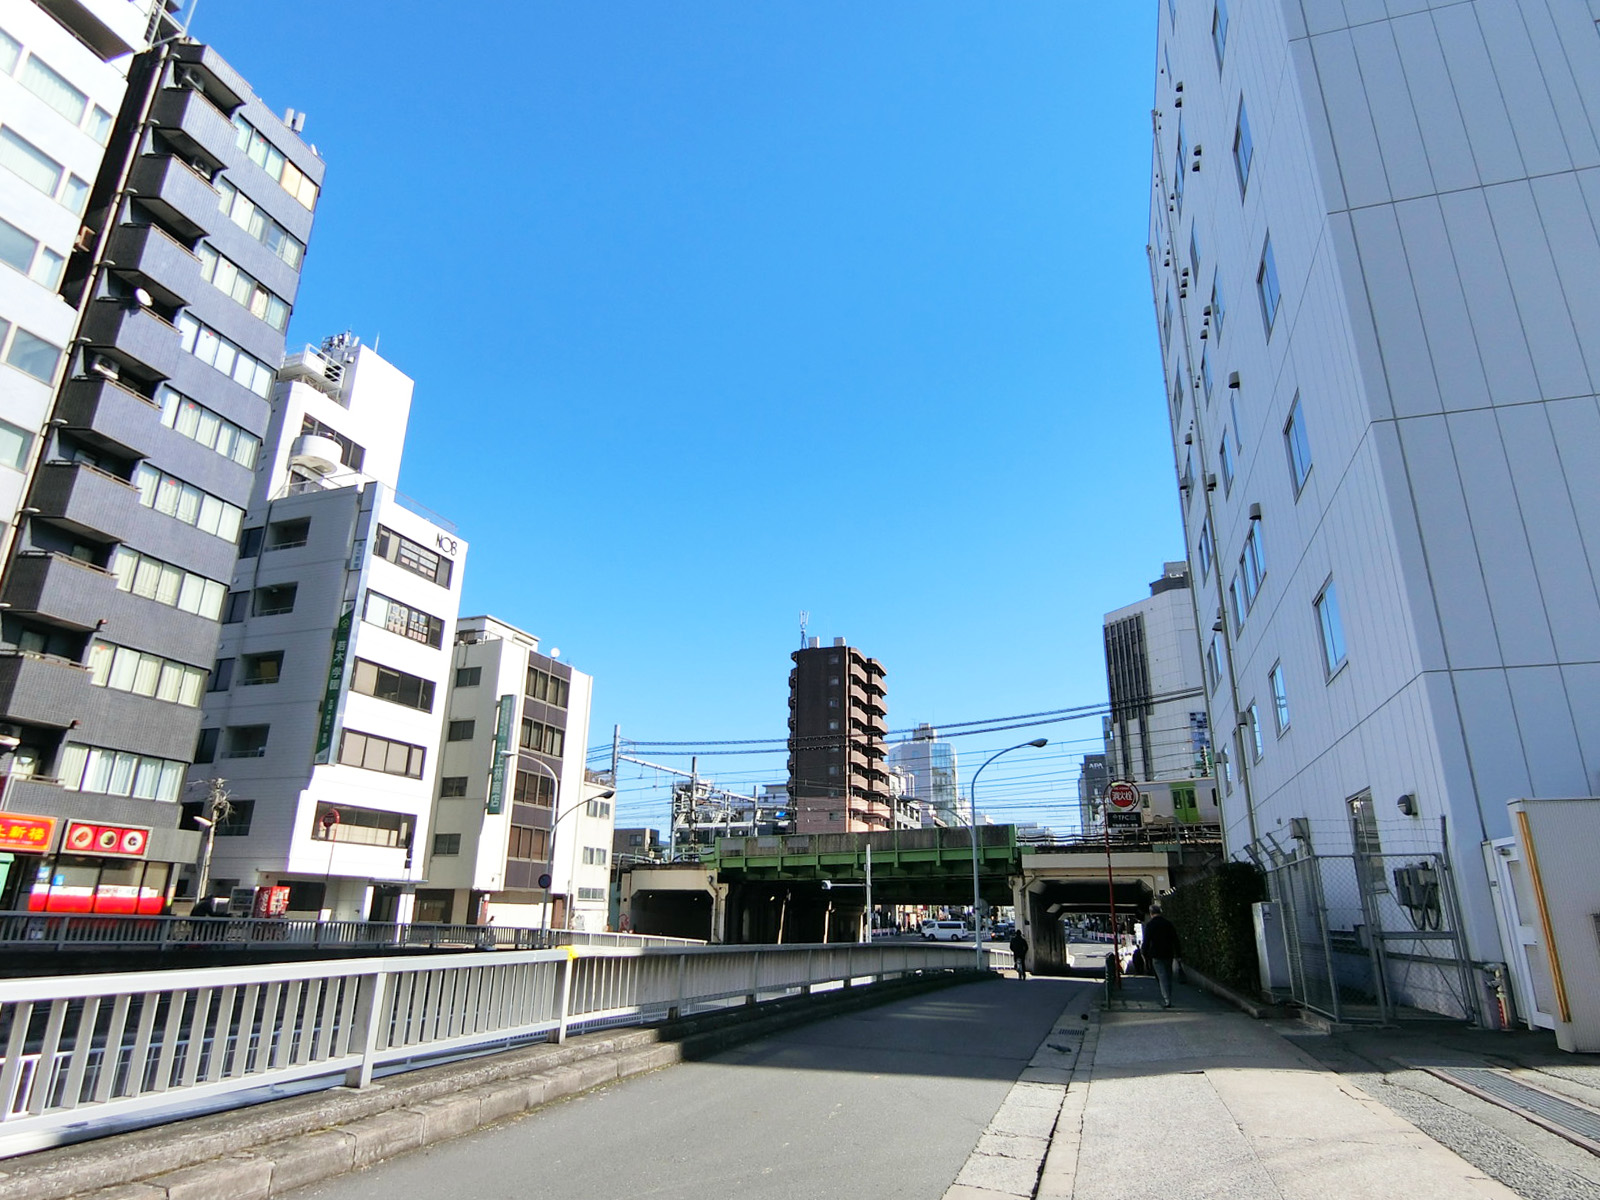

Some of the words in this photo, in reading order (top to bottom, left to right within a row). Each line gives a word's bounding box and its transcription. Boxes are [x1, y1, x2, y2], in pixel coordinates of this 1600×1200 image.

[436, 533, 458, 556] NOB
[1112, 791, 1133, 801] 消火栓
